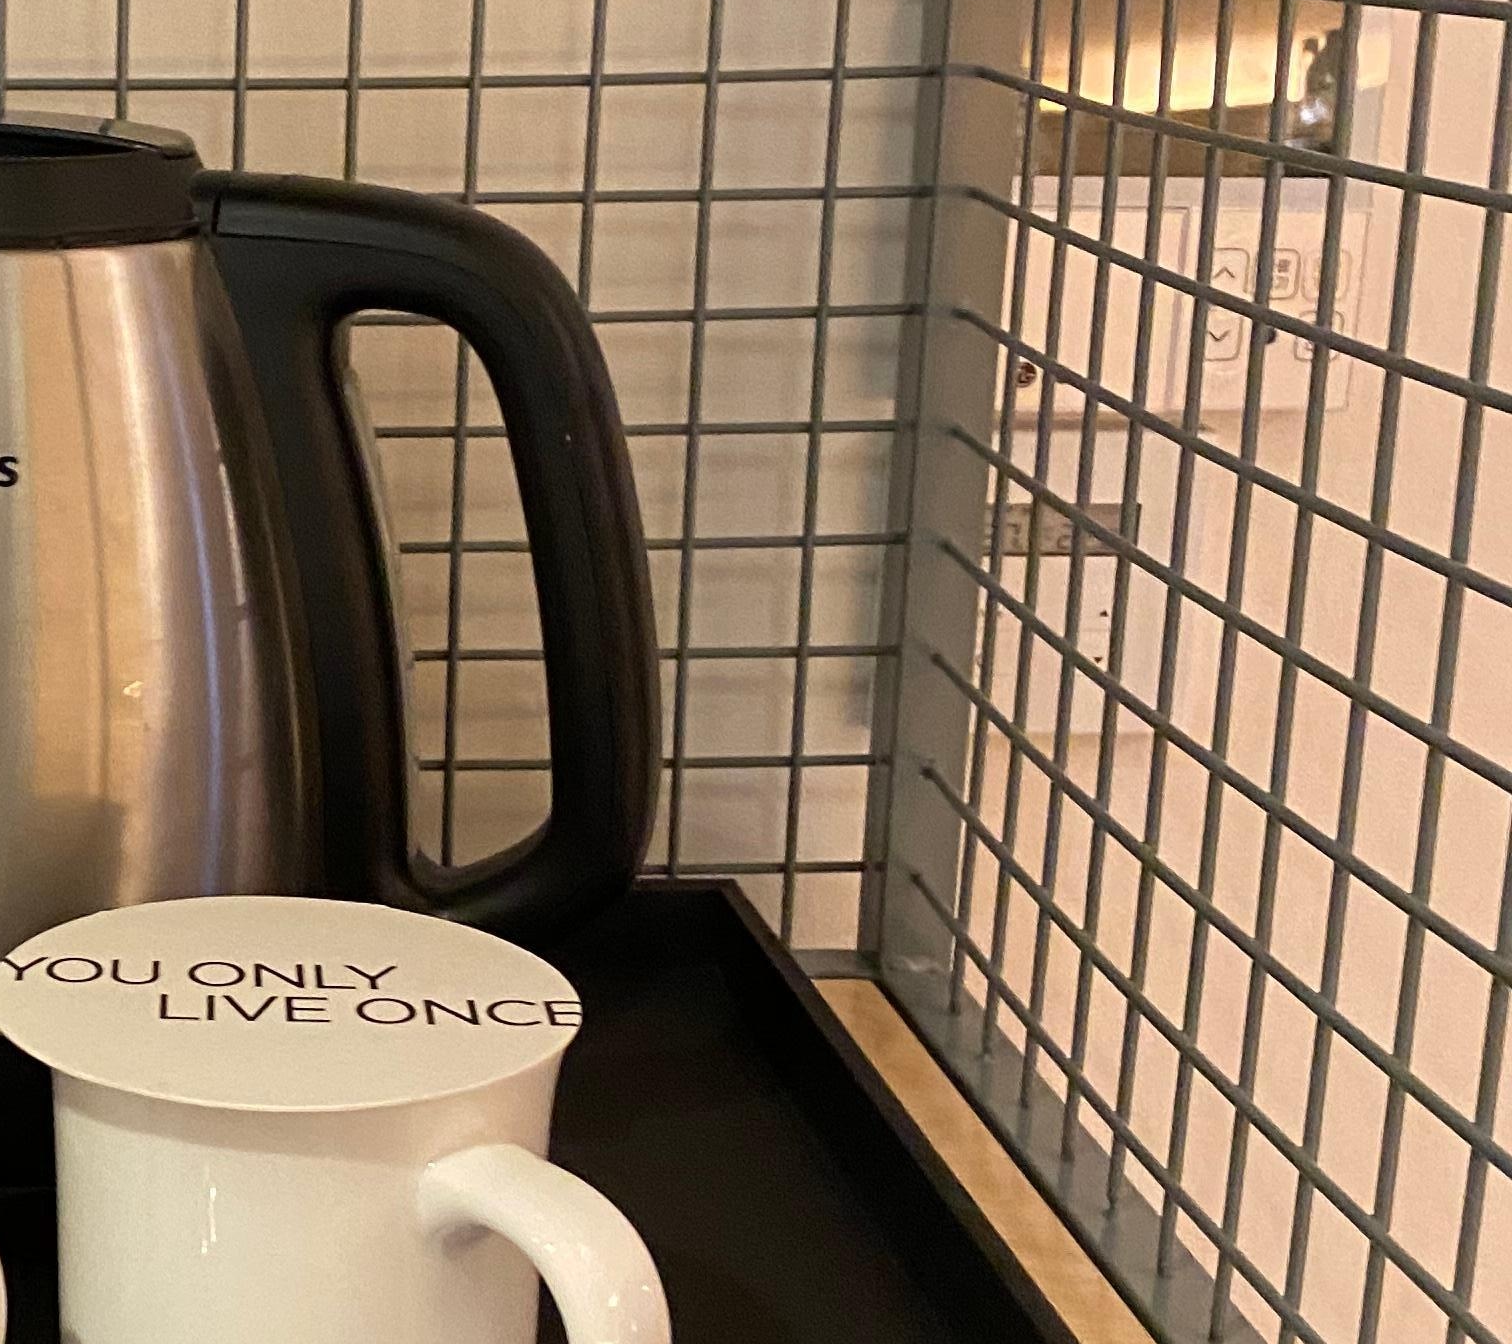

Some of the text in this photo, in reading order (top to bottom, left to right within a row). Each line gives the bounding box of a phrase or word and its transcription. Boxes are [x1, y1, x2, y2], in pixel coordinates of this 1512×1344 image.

[2, 956, 397, 991] YOU ONLY
[158, 993, 583, 1028] LIVE ONCE
